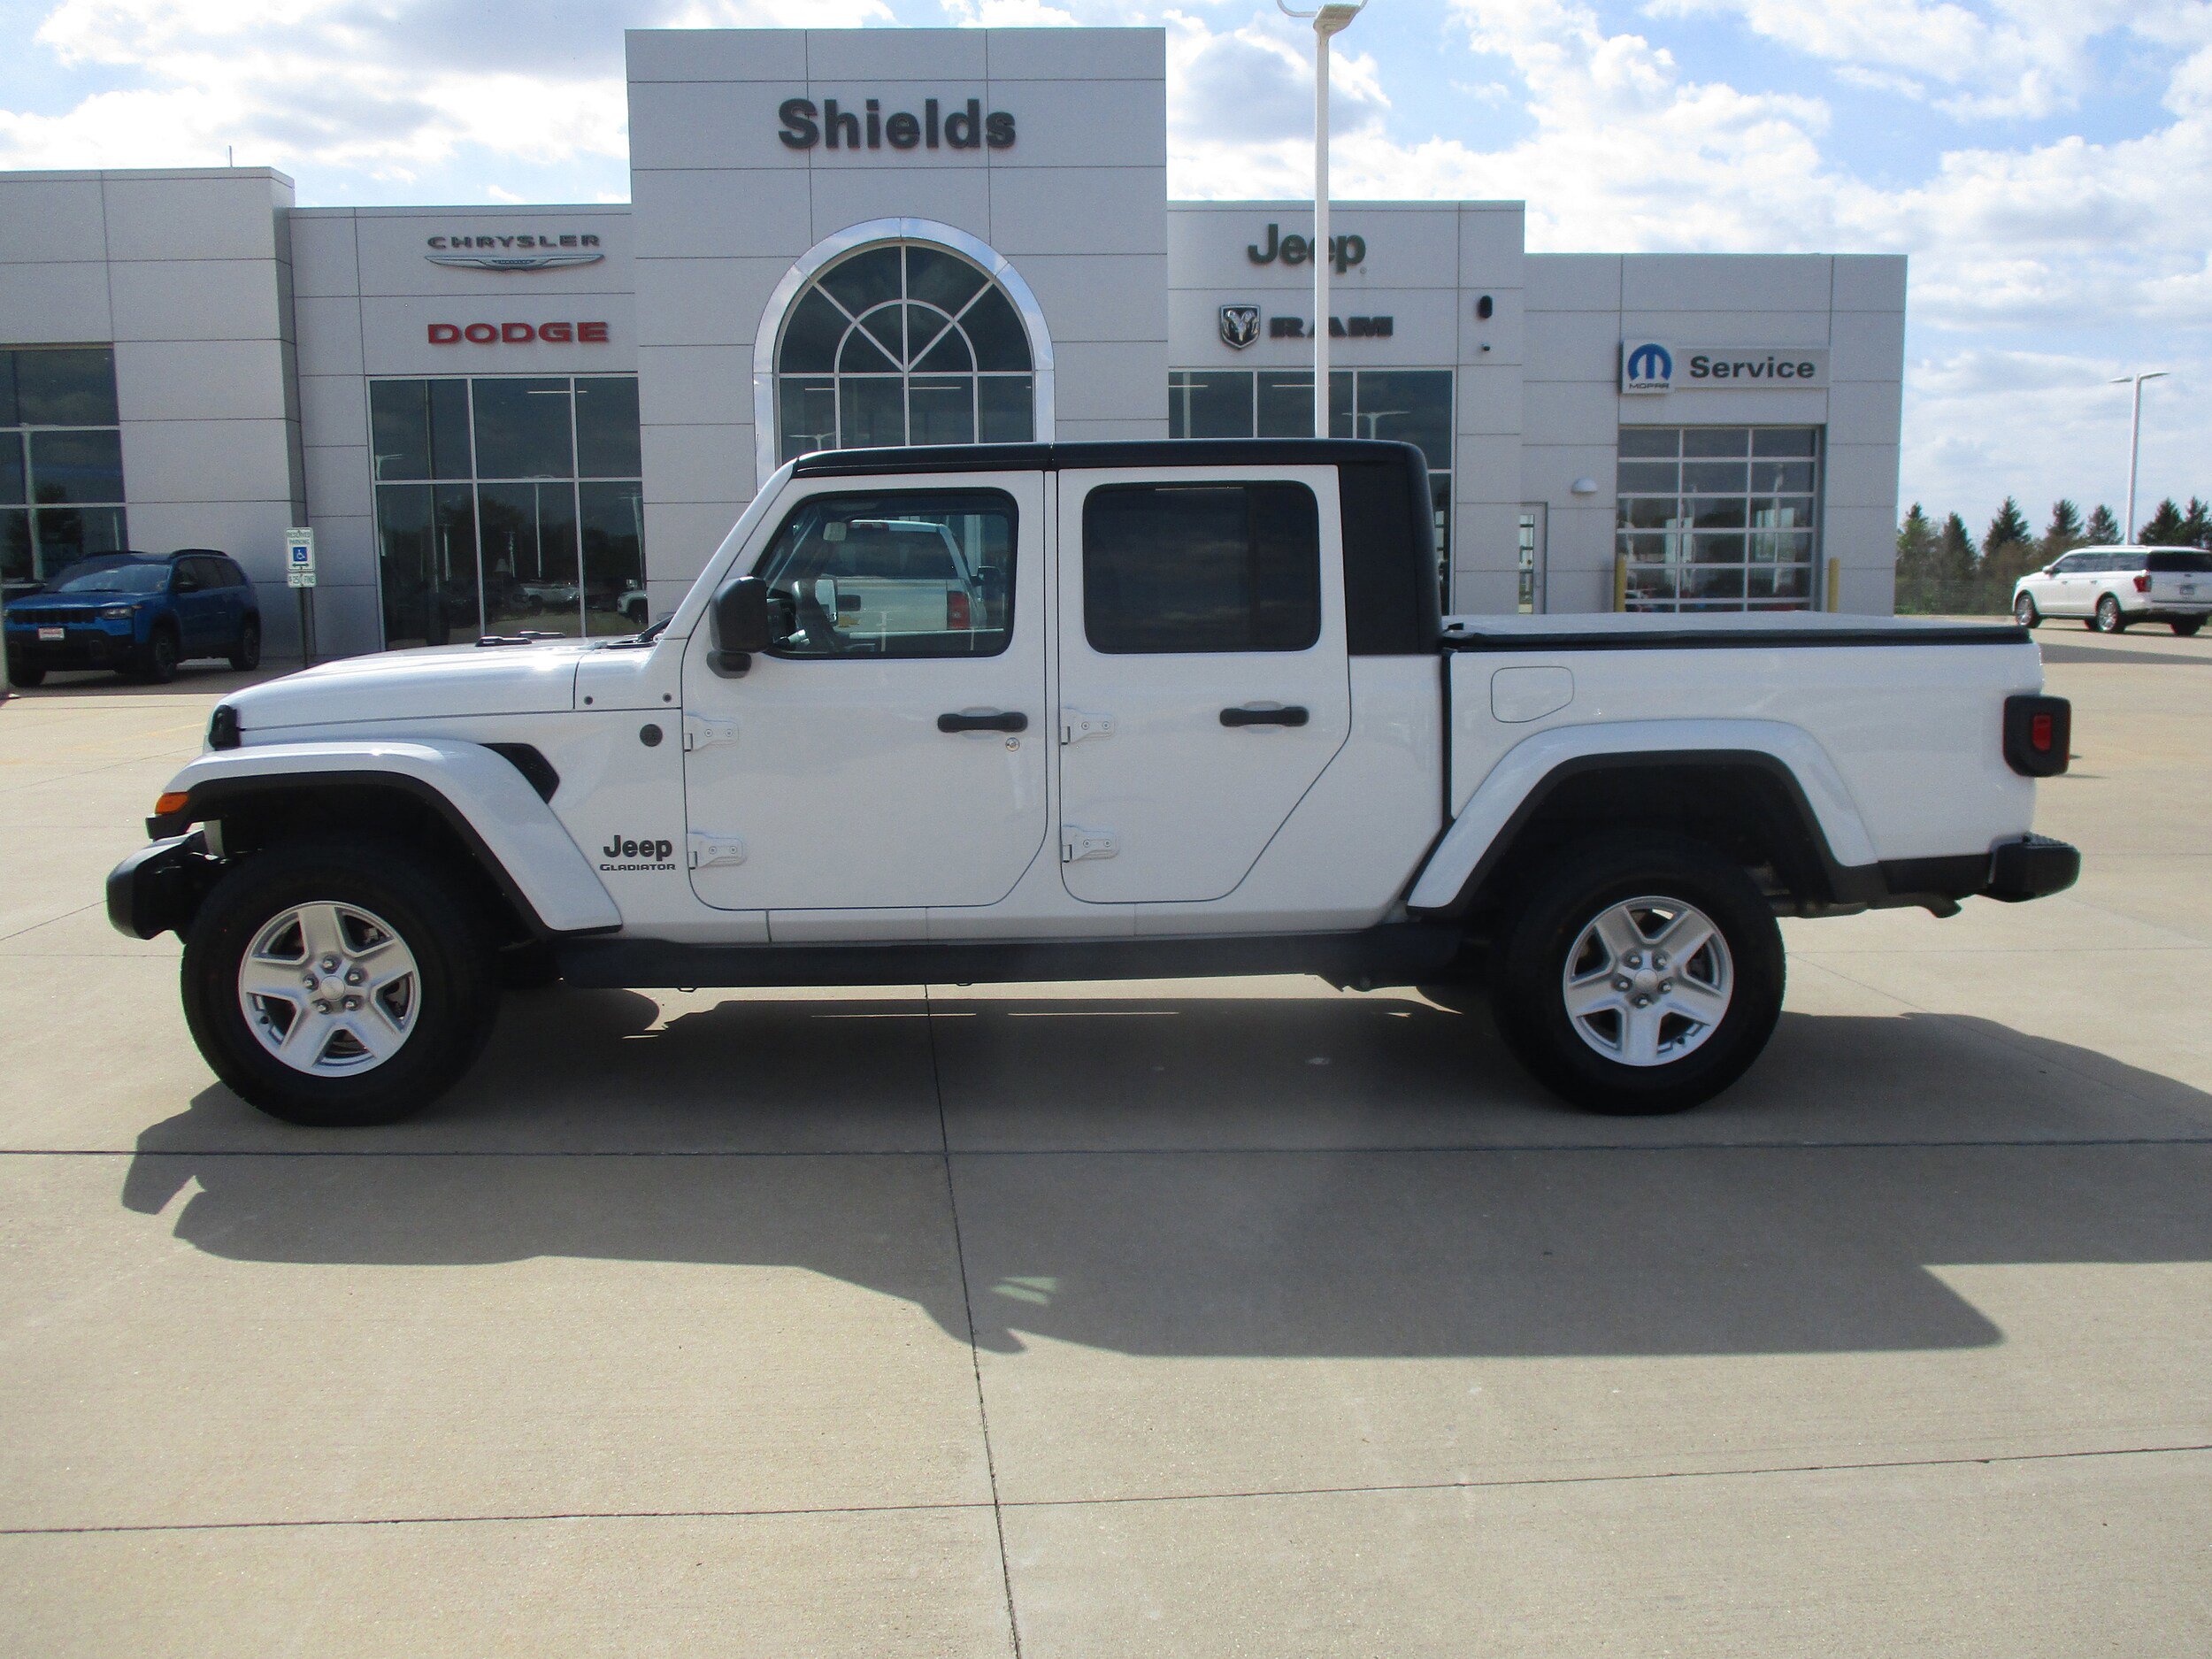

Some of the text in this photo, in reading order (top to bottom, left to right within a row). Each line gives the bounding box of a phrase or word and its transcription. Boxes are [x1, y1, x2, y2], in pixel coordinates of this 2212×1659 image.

[778, 97, 1016, 149] Shields
[427, 234, 600, 249] CHRYSLER
[427, 321, 609, 343] DODGE
[1689, 356, 1815, 379] Service
[603, 834, 672, 862] Jeep
